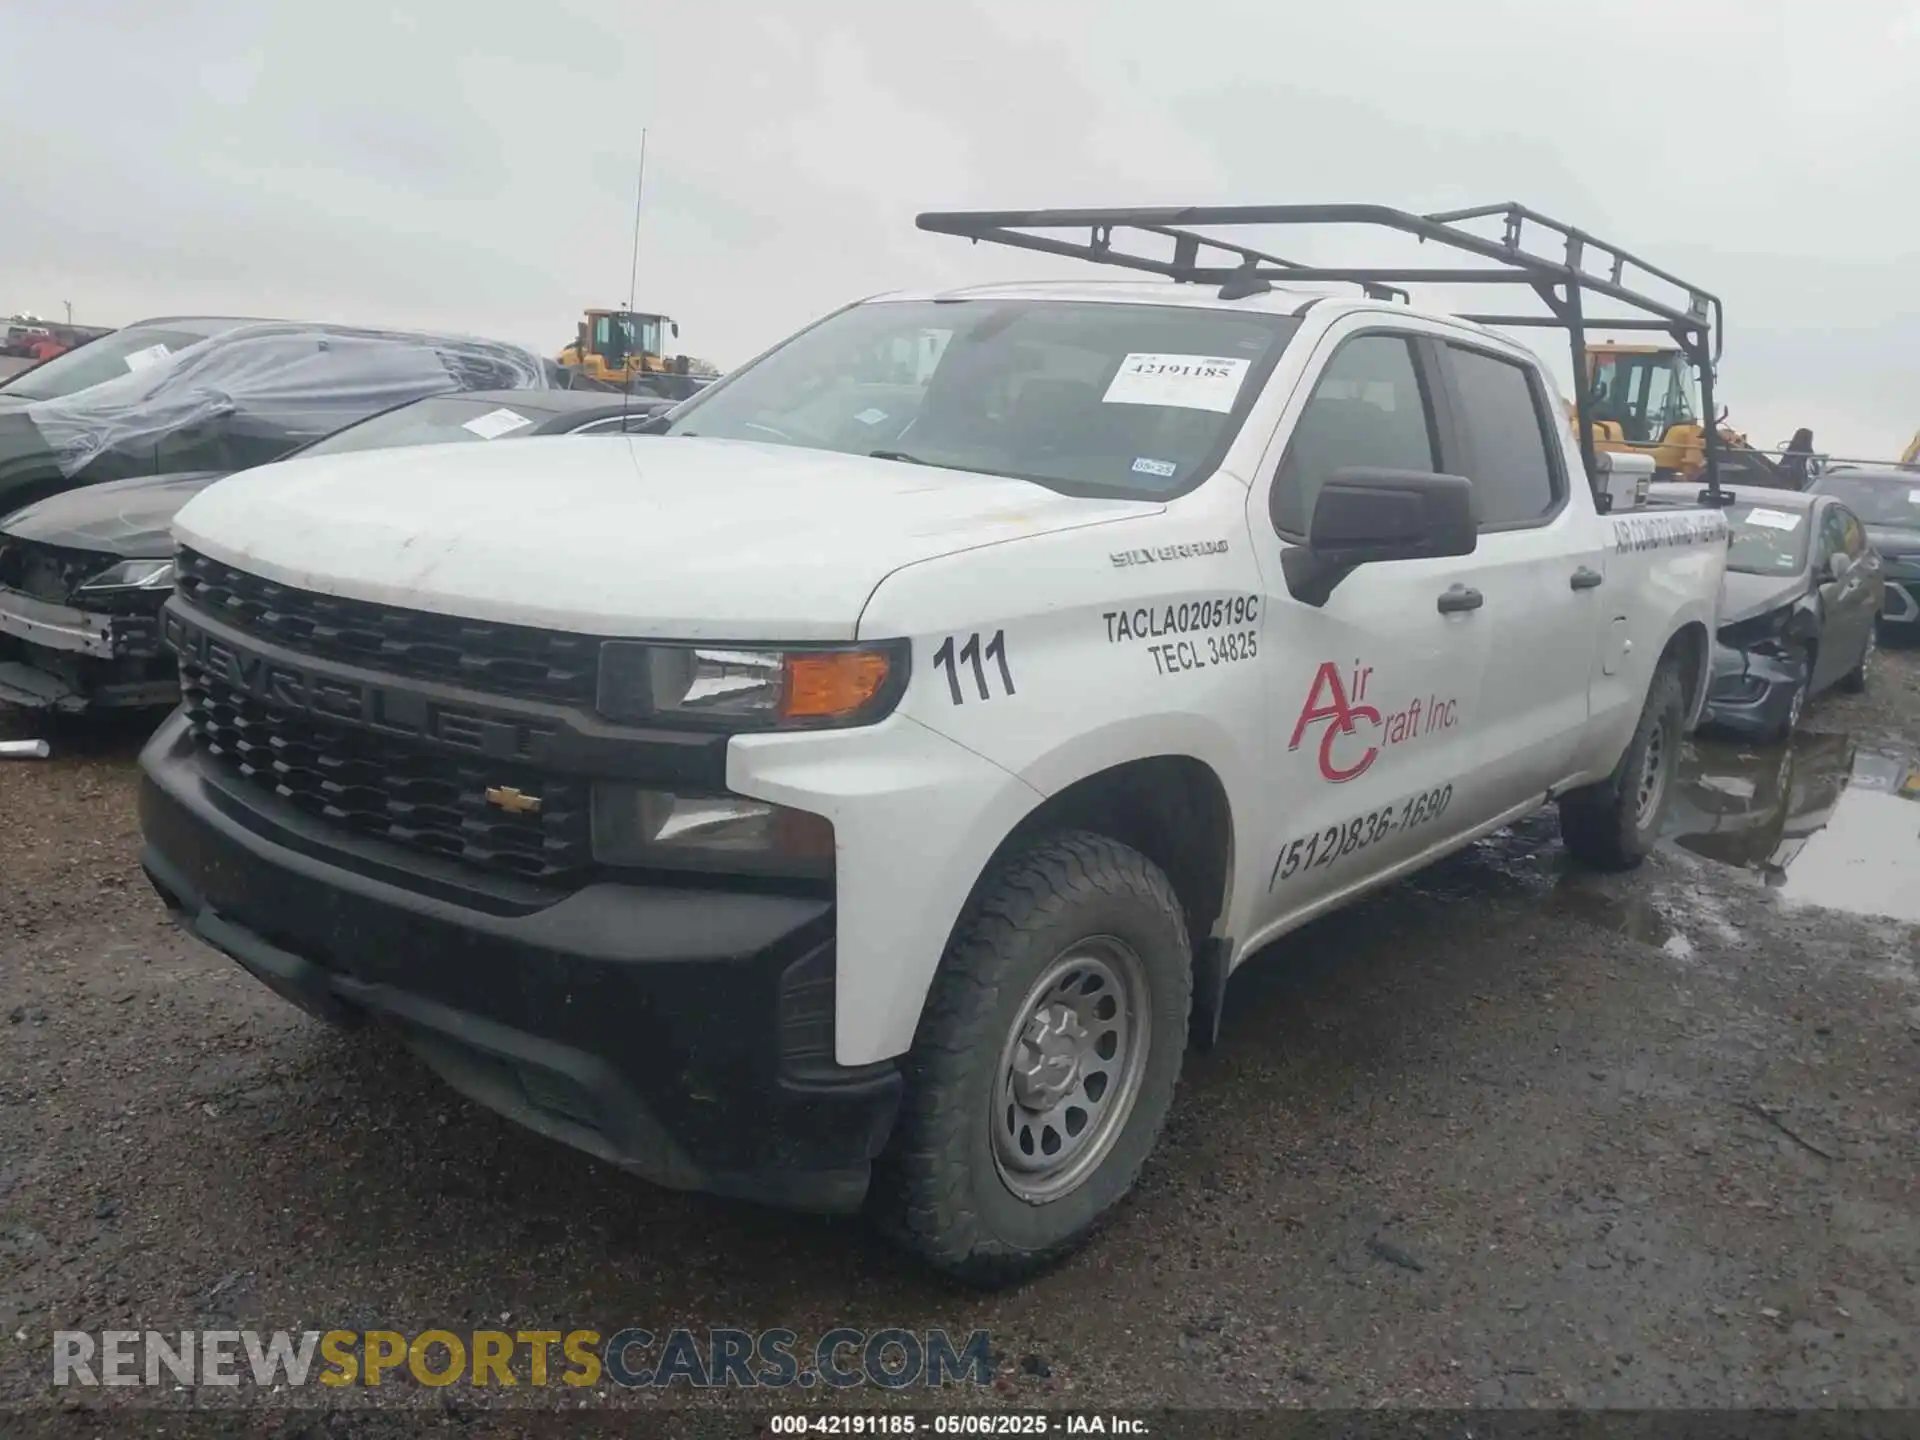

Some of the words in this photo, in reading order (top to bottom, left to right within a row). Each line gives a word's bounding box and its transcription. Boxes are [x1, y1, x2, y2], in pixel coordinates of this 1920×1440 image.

[1131, 363, 1232, 378] 42191185
[1110, 539, 1229, 568] SILVERADO
[1102, 594, 1259, 643] TACLA020519C
[933, 629, 1016, 705] 111
[1147, 640, 1206, 675] TECL
[1207, 630, 1258, 665] 34825
[1287, 658, 1374, 751] Air
[1425, 694, 1459, 734] Inc.
[1318, 697, 1421, 784] Craft
[1268, 783, 1454, 894] (512)836-1690
